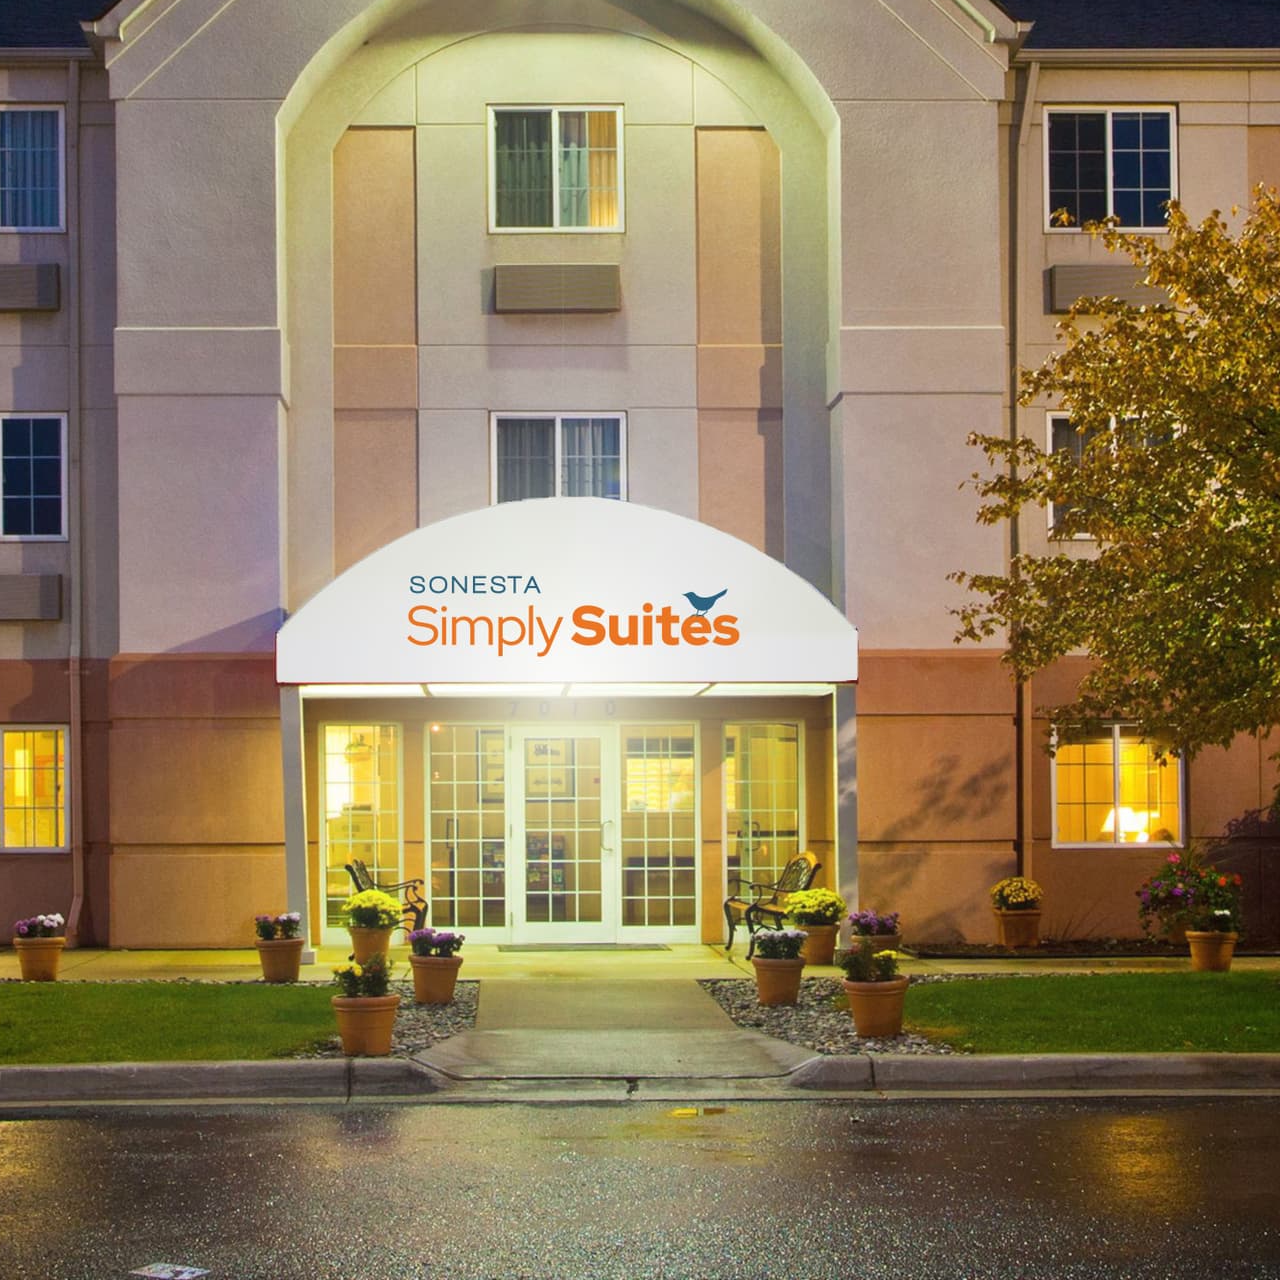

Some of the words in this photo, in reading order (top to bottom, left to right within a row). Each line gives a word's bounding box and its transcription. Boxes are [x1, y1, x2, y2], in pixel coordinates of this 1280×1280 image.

[410, 575, 541, 594] SONESTA
[407, 604, 564, 657] Simply
[571, 602, 741, 646] Suites
